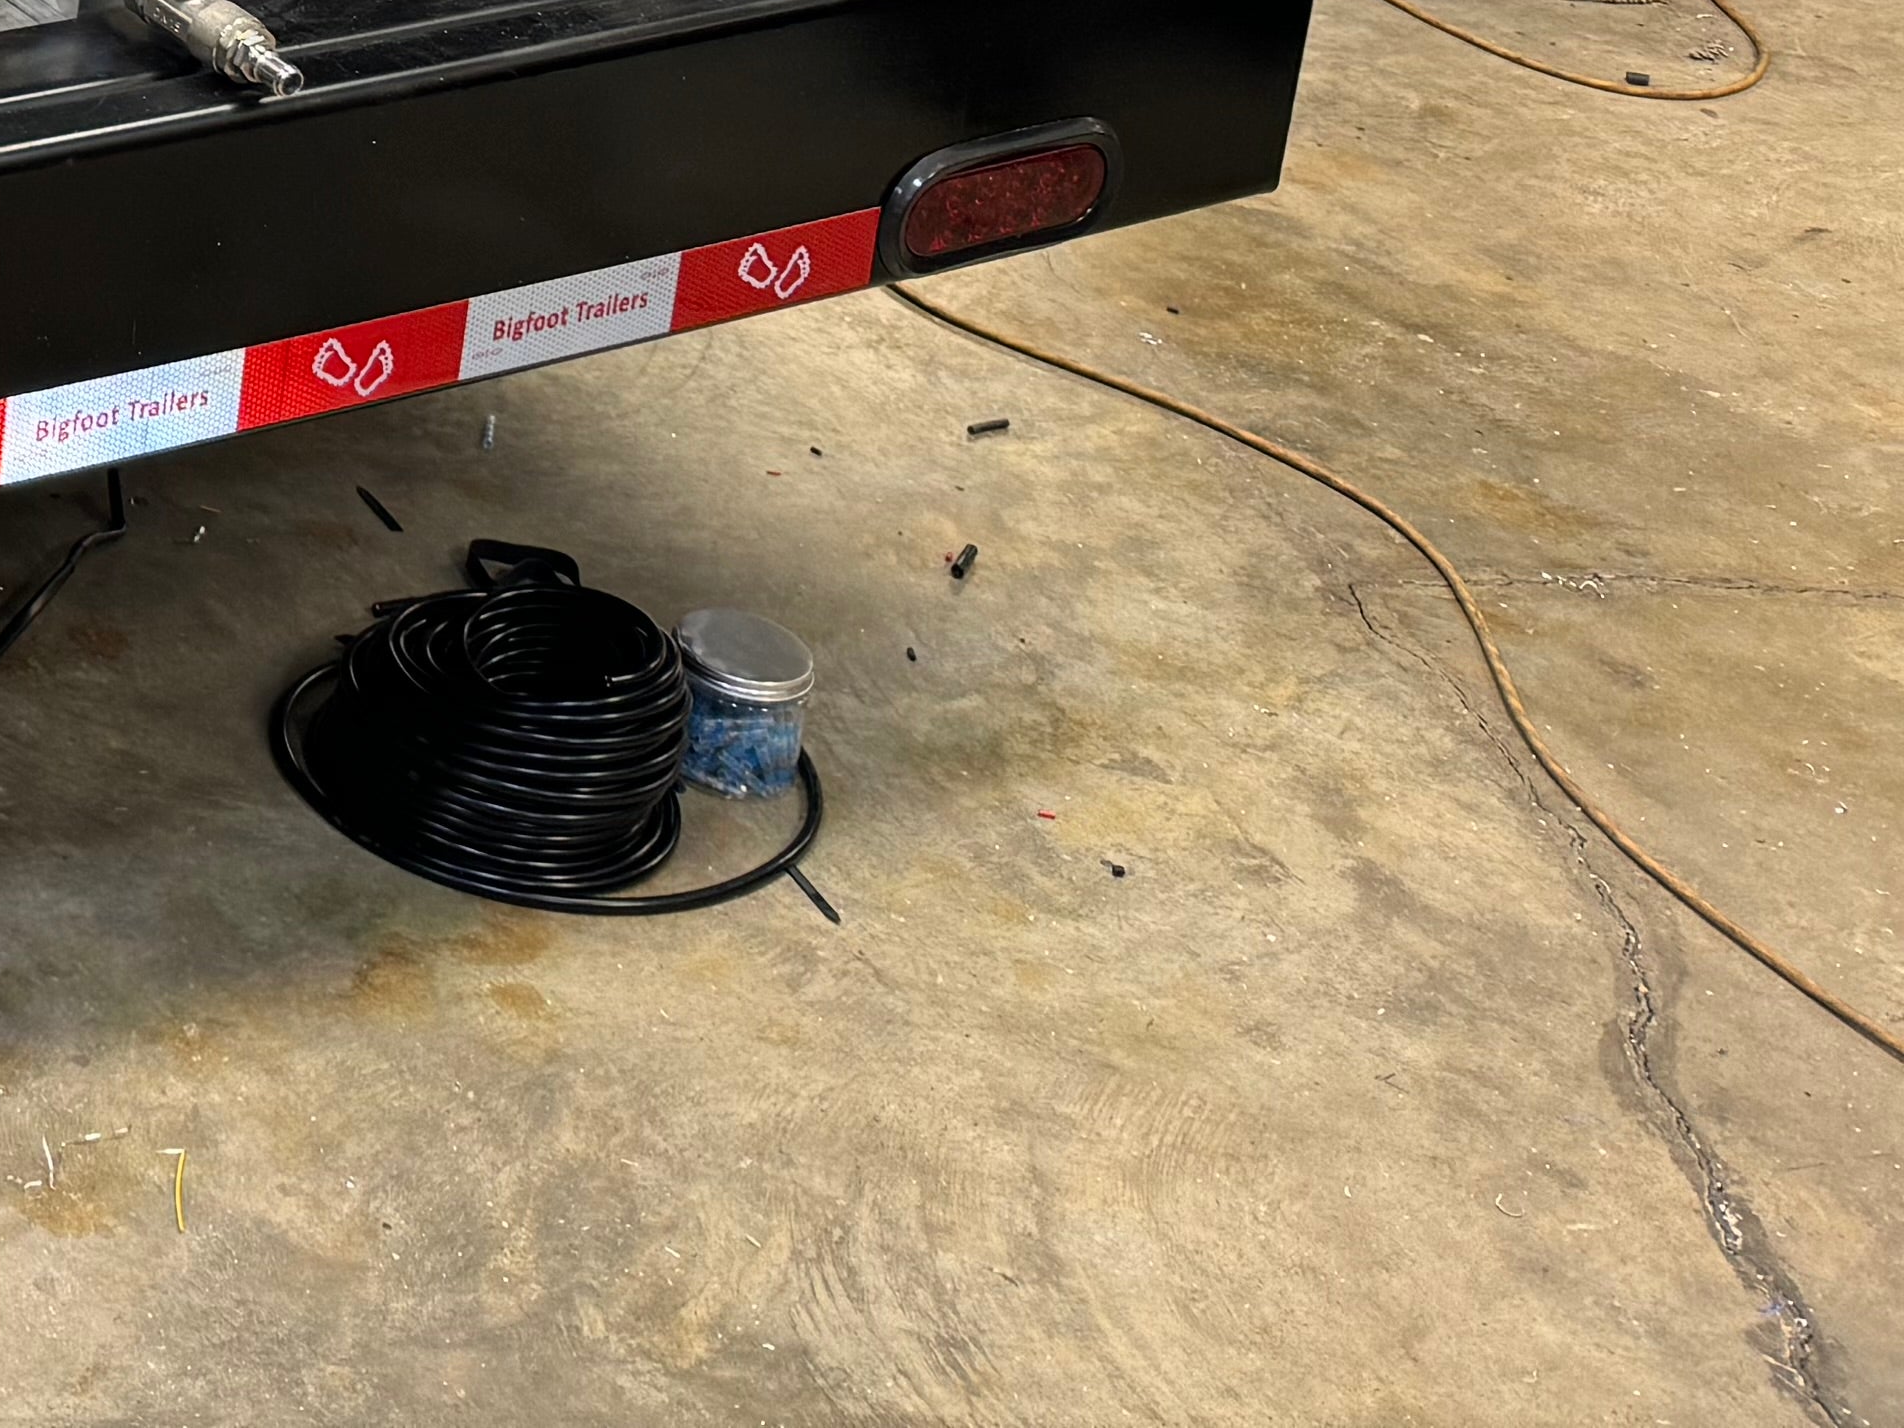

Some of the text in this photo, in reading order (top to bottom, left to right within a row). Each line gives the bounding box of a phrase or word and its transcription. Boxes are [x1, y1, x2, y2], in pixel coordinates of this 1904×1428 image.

[492, 292, 650, 343] Bigfoot Trailers
[35, 388, 210, 444] Bigfoot Trailers
